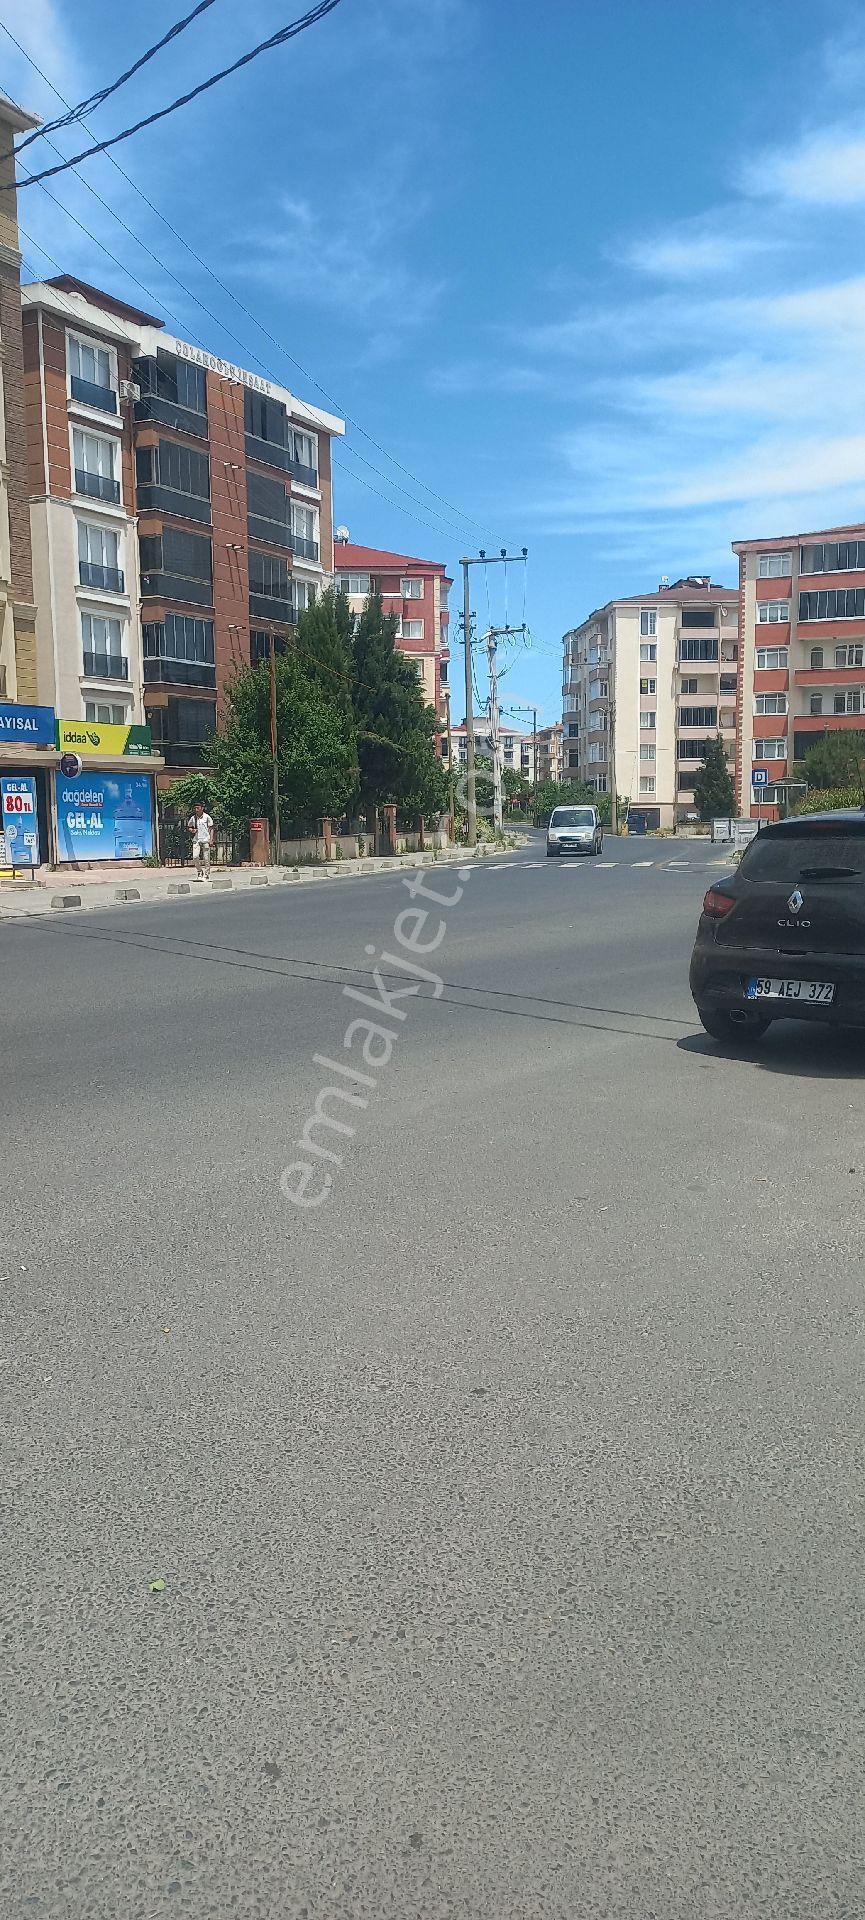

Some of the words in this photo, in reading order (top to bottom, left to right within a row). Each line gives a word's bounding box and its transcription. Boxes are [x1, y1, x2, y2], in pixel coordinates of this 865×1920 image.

[63, 731, 87, 744] iddaa
[6, 783, 28, 792] GEL-AL
[6, 796, 22, 812] 80
[24, 803, 32, 812] TL
[66, 811, 104, 829] GEL-AL
[777, 919, 811, 928] CLIO
[757, 980, 772, 994] 59
[778, 981, 802, 997] AEJ
[809, 983, 833, 1000] 372
